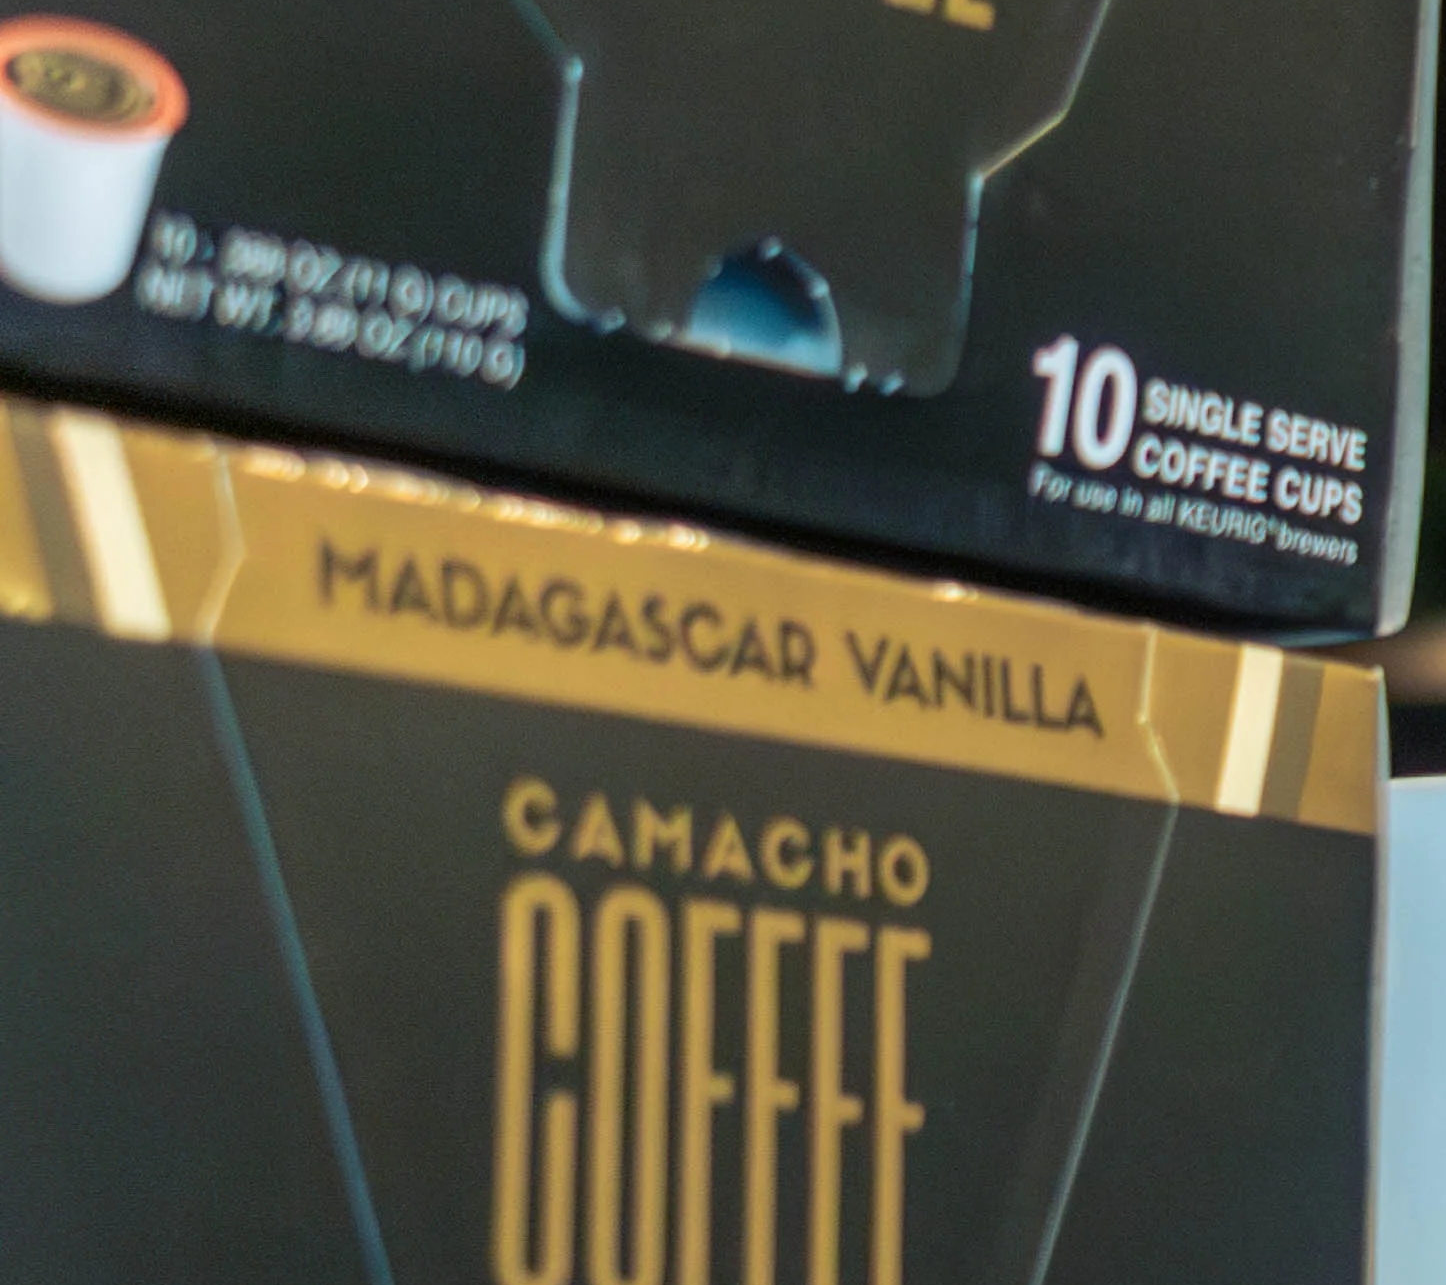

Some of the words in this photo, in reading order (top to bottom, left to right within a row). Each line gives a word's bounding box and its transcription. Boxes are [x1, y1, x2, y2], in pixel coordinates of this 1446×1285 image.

[1031, 334, 1137, 470] 10
[1144, 378, 1262, 444] SINGLE
[1267, 409, 1367, 471] SERVE
[1030, 461, 1073, 501] For
[1133, 433, 1270, 504] COFFEE
[1275, 467, 1363, 524] CUPS
[315, 538, 817, 688] MADAGASCAR
[848, 631, 1105, 739] VANILLA
[503, 777, 930, 906] CAMACHO
